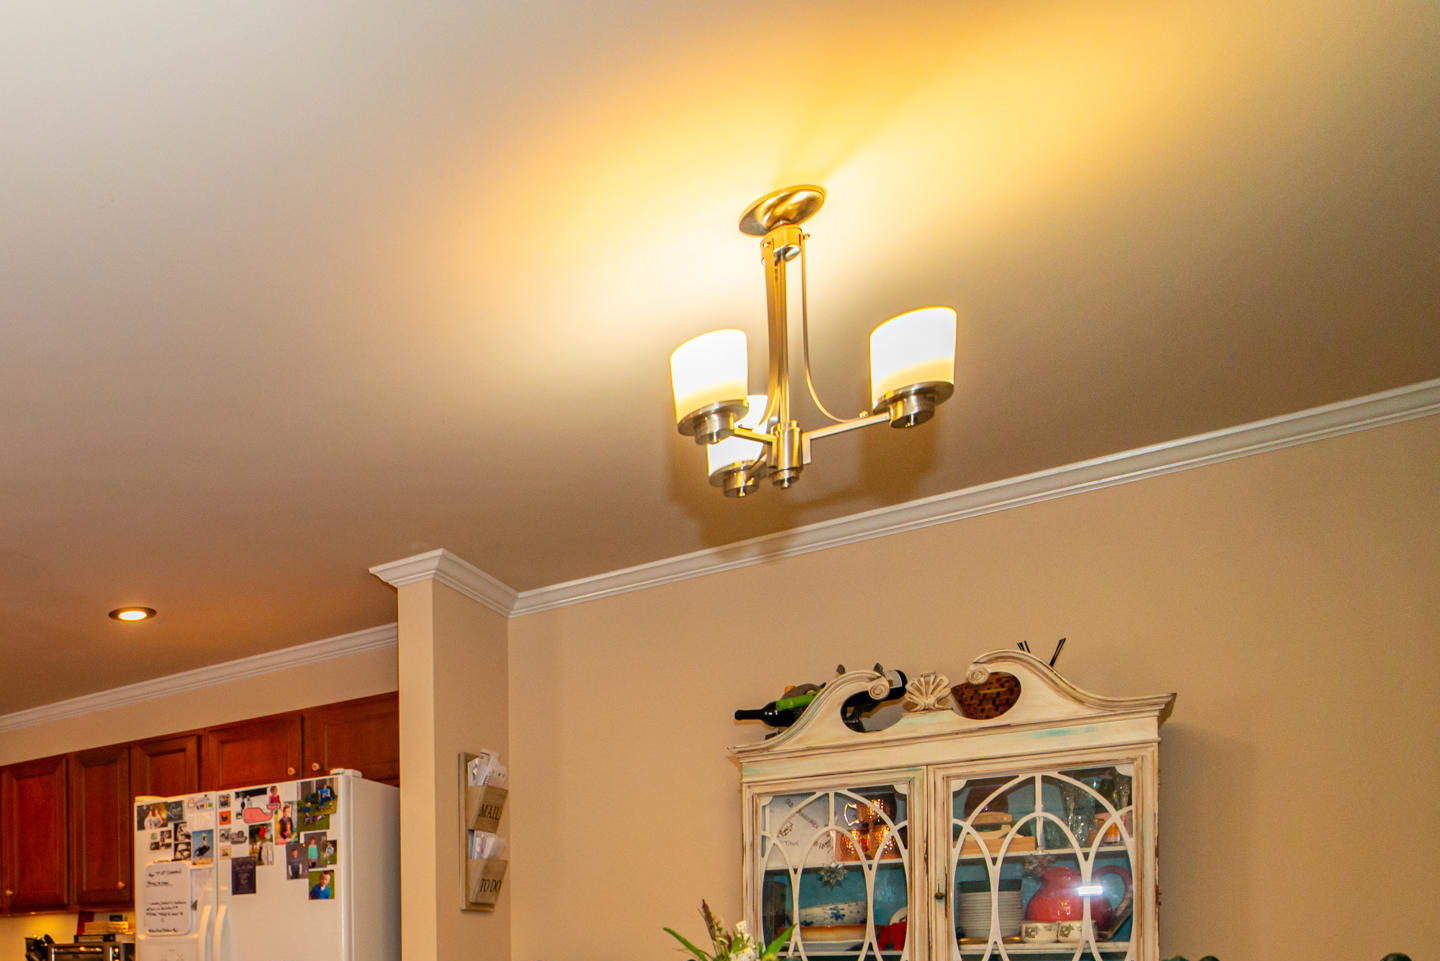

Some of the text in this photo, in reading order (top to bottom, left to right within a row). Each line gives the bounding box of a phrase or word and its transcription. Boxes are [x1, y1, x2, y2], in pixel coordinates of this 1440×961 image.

[479, 803, 500, 820] MAIL
[480, 878, 502, 893] TO DO
